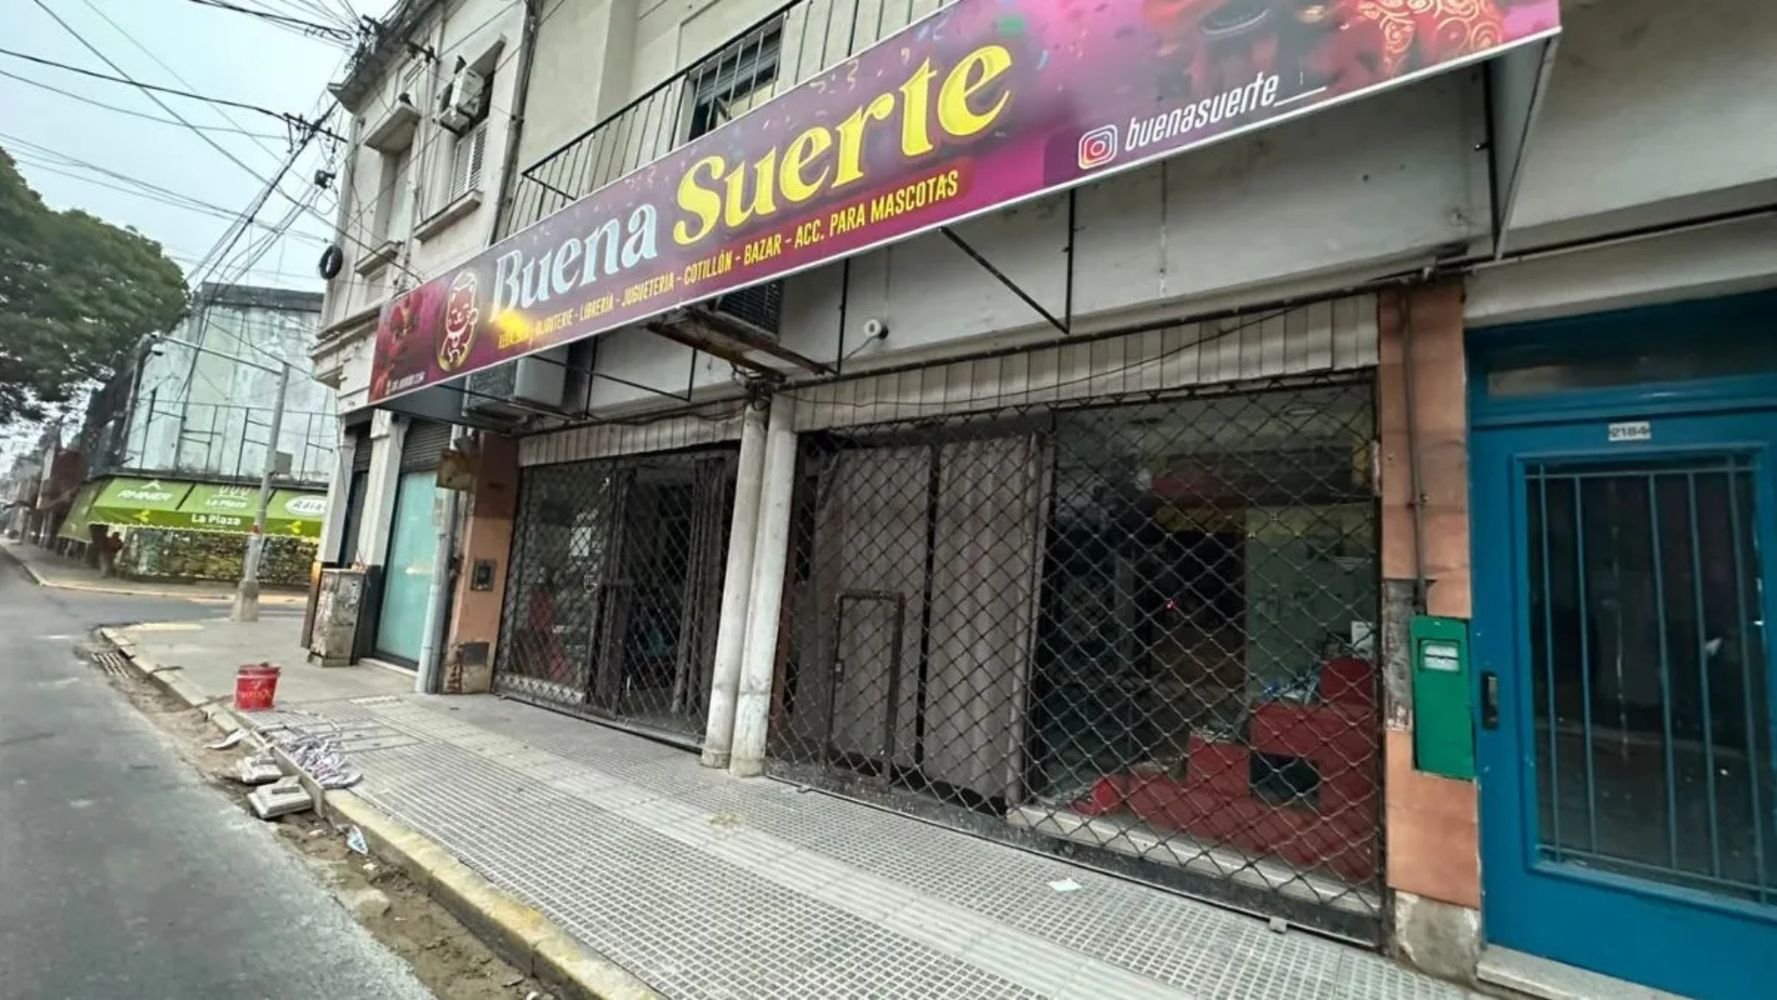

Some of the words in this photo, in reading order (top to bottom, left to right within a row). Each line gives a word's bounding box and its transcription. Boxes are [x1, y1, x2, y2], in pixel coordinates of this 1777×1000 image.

[489, 203, 658, 323] Buena
[672, 44, 1013, 246] Suerte
[684, 252, 733, 286] COTILLÓN
[743, 237, 782, 266] BAZAR
[795, 219, 825, 250] ACC.
[830, 207, 866, 237] PARA
[870, 170, 959, 221] MASCOTAS
[1609, 426, 1649, 438] 2184
[191, 513, 207, 523] La
[208, 514, 241, 526] Plaza
